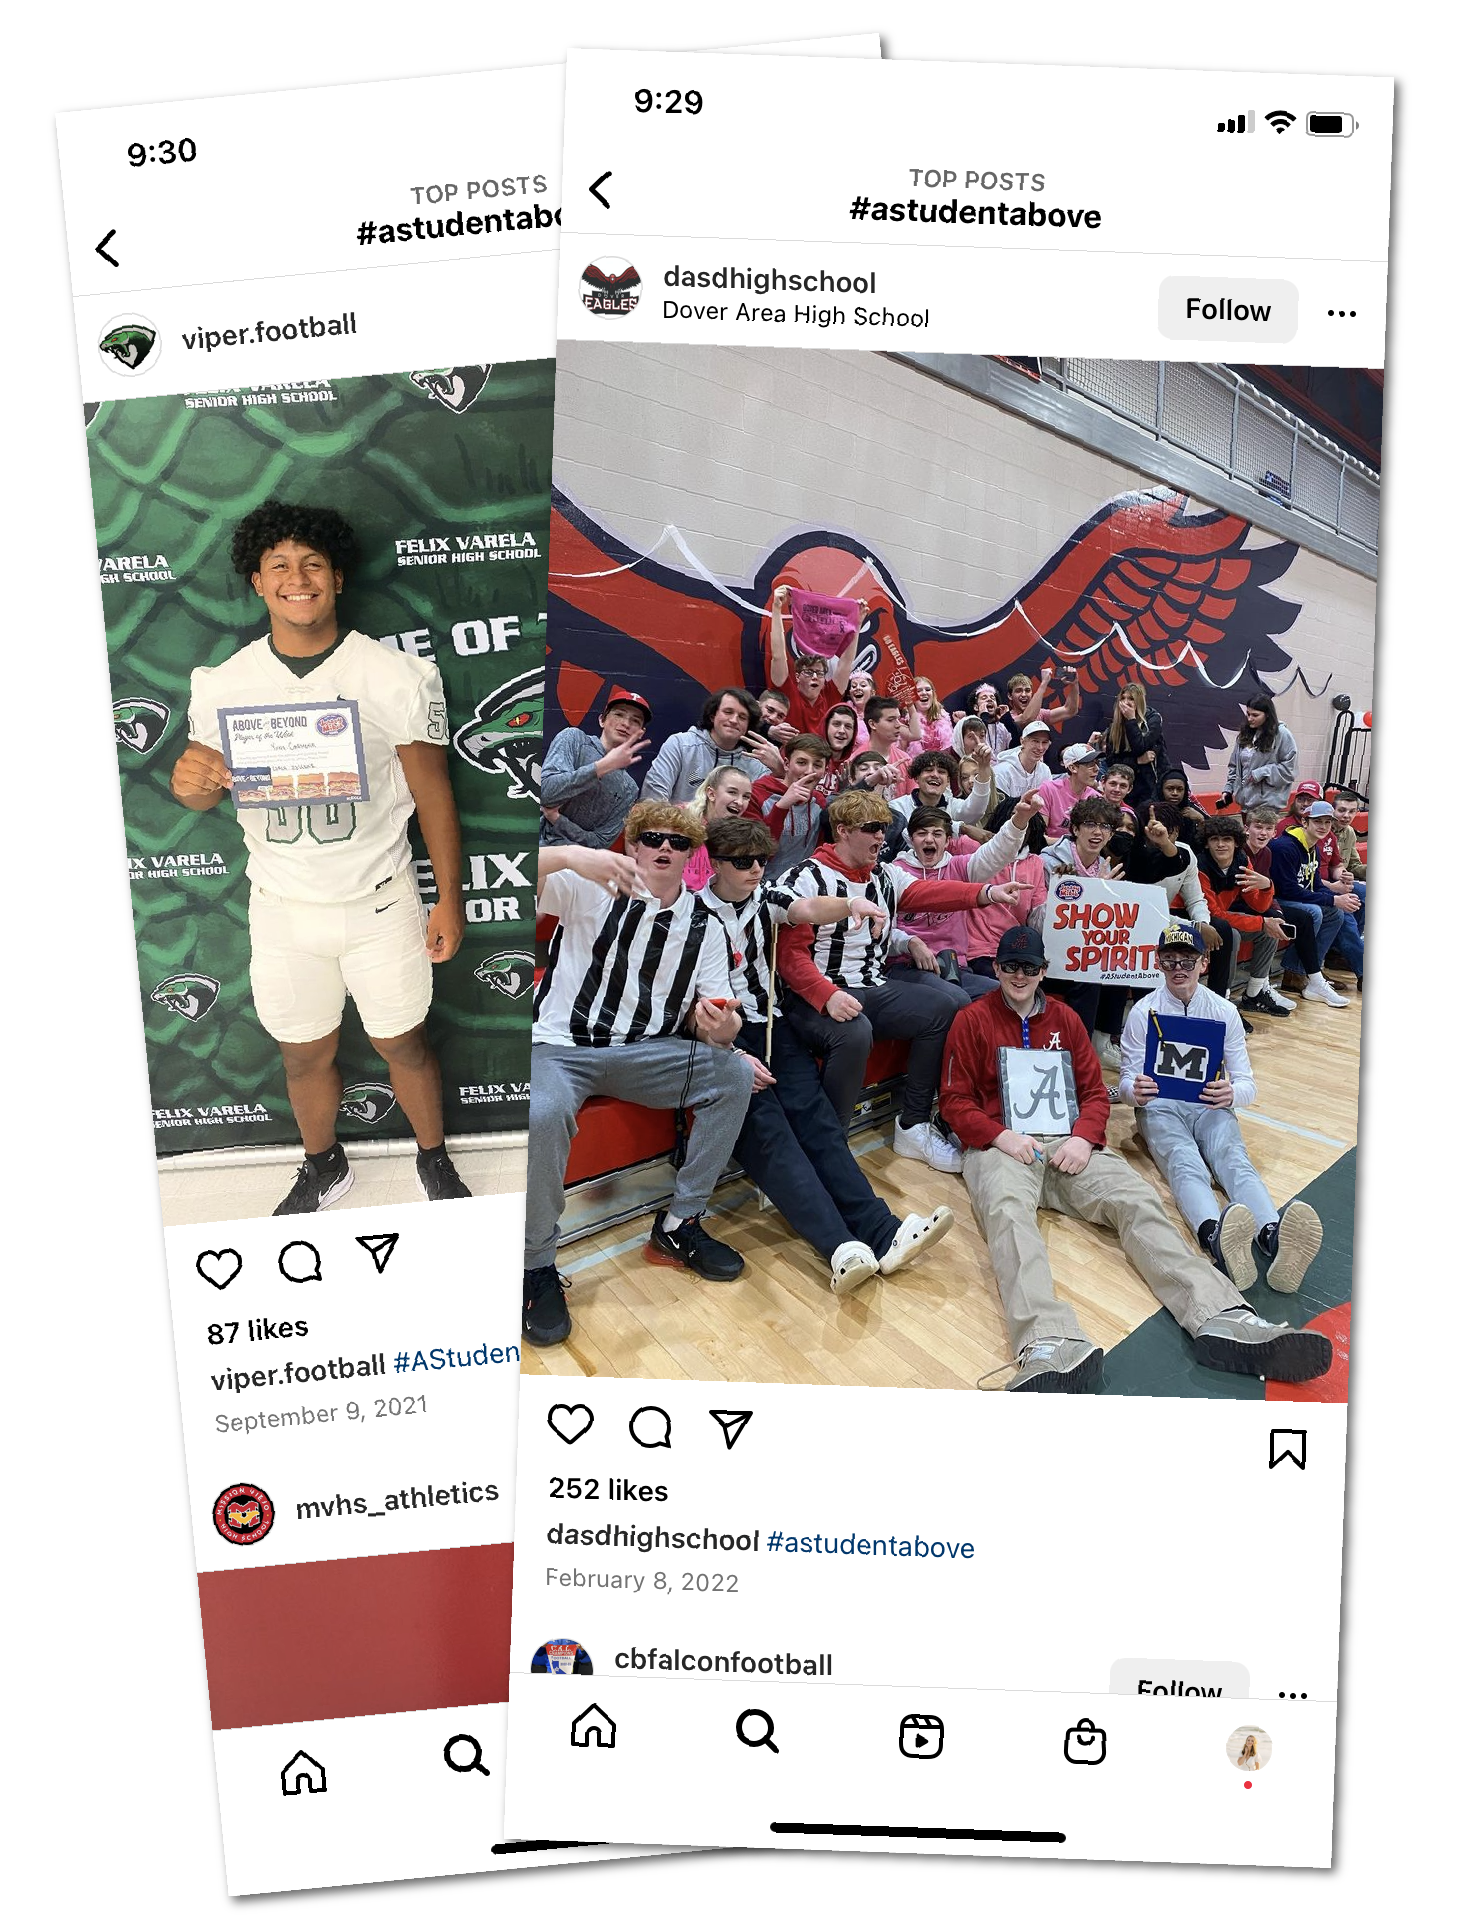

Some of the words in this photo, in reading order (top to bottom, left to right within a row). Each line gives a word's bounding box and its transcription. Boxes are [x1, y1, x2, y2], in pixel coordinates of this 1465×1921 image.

[634, 88, 704, 116] 9:29
[127, 137, 197, 167] 9:30
[410, 182, 459, 206] TOP
[467, 174, 548, 201] POSTS
[909, 167, 957, 189] TOP
[964, 169, 1046, 192] POSTS
[850, 196, 1102, 229] #astudentabove
[663, 265, 877, 294] dasdhighschool
[585, 296, 637, 311] EAGLES
[663, 300, 728, 322] Dover
[735, 302, 786, 322] Area
[794, 304, 846, 328] High
[853, 306, 930, 328] School
[1186, 297, 1272, 322] Follow
[182, 312, 358, 352] viper.football
[184, 395, 239, 409] SENIOR
[242, 393, 278, 406] HIGH
[281, 390, 338, 404] SCHOOL
[395, 537, 451, 554] FELIX
[456, 531, 537, 551] VARELA
[397, 553, 448, 567] SENIOR
[452, 551, 485, 563] HIGH
[489, 548, 542, 561] SCHOOL
[123, 570, 177, 582] SCHOOL
[451, 615, 521, 656] OF
[233, 718, 263, 732] ABOVE
[271, 716, 308, 730] BEYOND
[148, 869, 178, 879] HIGH
[182, 865, 230, 876] SCHOOL
[151, 853, 224, 868] VARELA
[1053, 902, 1140, 930] SHOW
[1082, 929, 1130, 945] YOUR
[1165, 931, 1194, 945] MICHIGAN
[1100, 972, 1160, 980] #AStudentAbove
[1043, 1031, 1063, 1051] A
[1157, 1042, 1207, 1080] M
[459, 1084, 506, 1096] FELIX
[460, 1095, 503, 1104] SENIOR
[1013, 1064, 1066, 1120] A
[197, 1103, 267, 1116] VARELA
[226, 1114, 273, 1124] SCHOOL
[207, 1322, 239, 1345] 87
[248, 1318, 309, 1342] likes
[211, 1353, 385, 1393] viper.football
[393, 1343, 520, 1374] #AStuden
[216, 1405, 339, 1434] September
[346, 1401, 366, 1423] 9,
[374, 1395, 428, 1418] 2021
[296, 1482, 499, 1520] mvhs_athletics
[548, 1476, 600, 1500] 252
[609, 1478, 669, 1501] likes
[216, 1487, 246, 1516] MISSION
[249, 1488, 270, 1511] VIEJO
[220, 1523, 239, 1540] HIGH
[241, 1520, 270, 1542] SCHOOL
[547, 1523, 760, 1552] dasdhighschool
[766, 1530, 975, 1560] #astudentabove
[546, 1567, 645, 1593] February
[653, 1571, 673, 1594] 8,
[681, 1572, 739, 1594] 2022
[615, 1648, 833, 1676] cbfalconfootball
[1138, 1680, 1223, 1698] Follow
